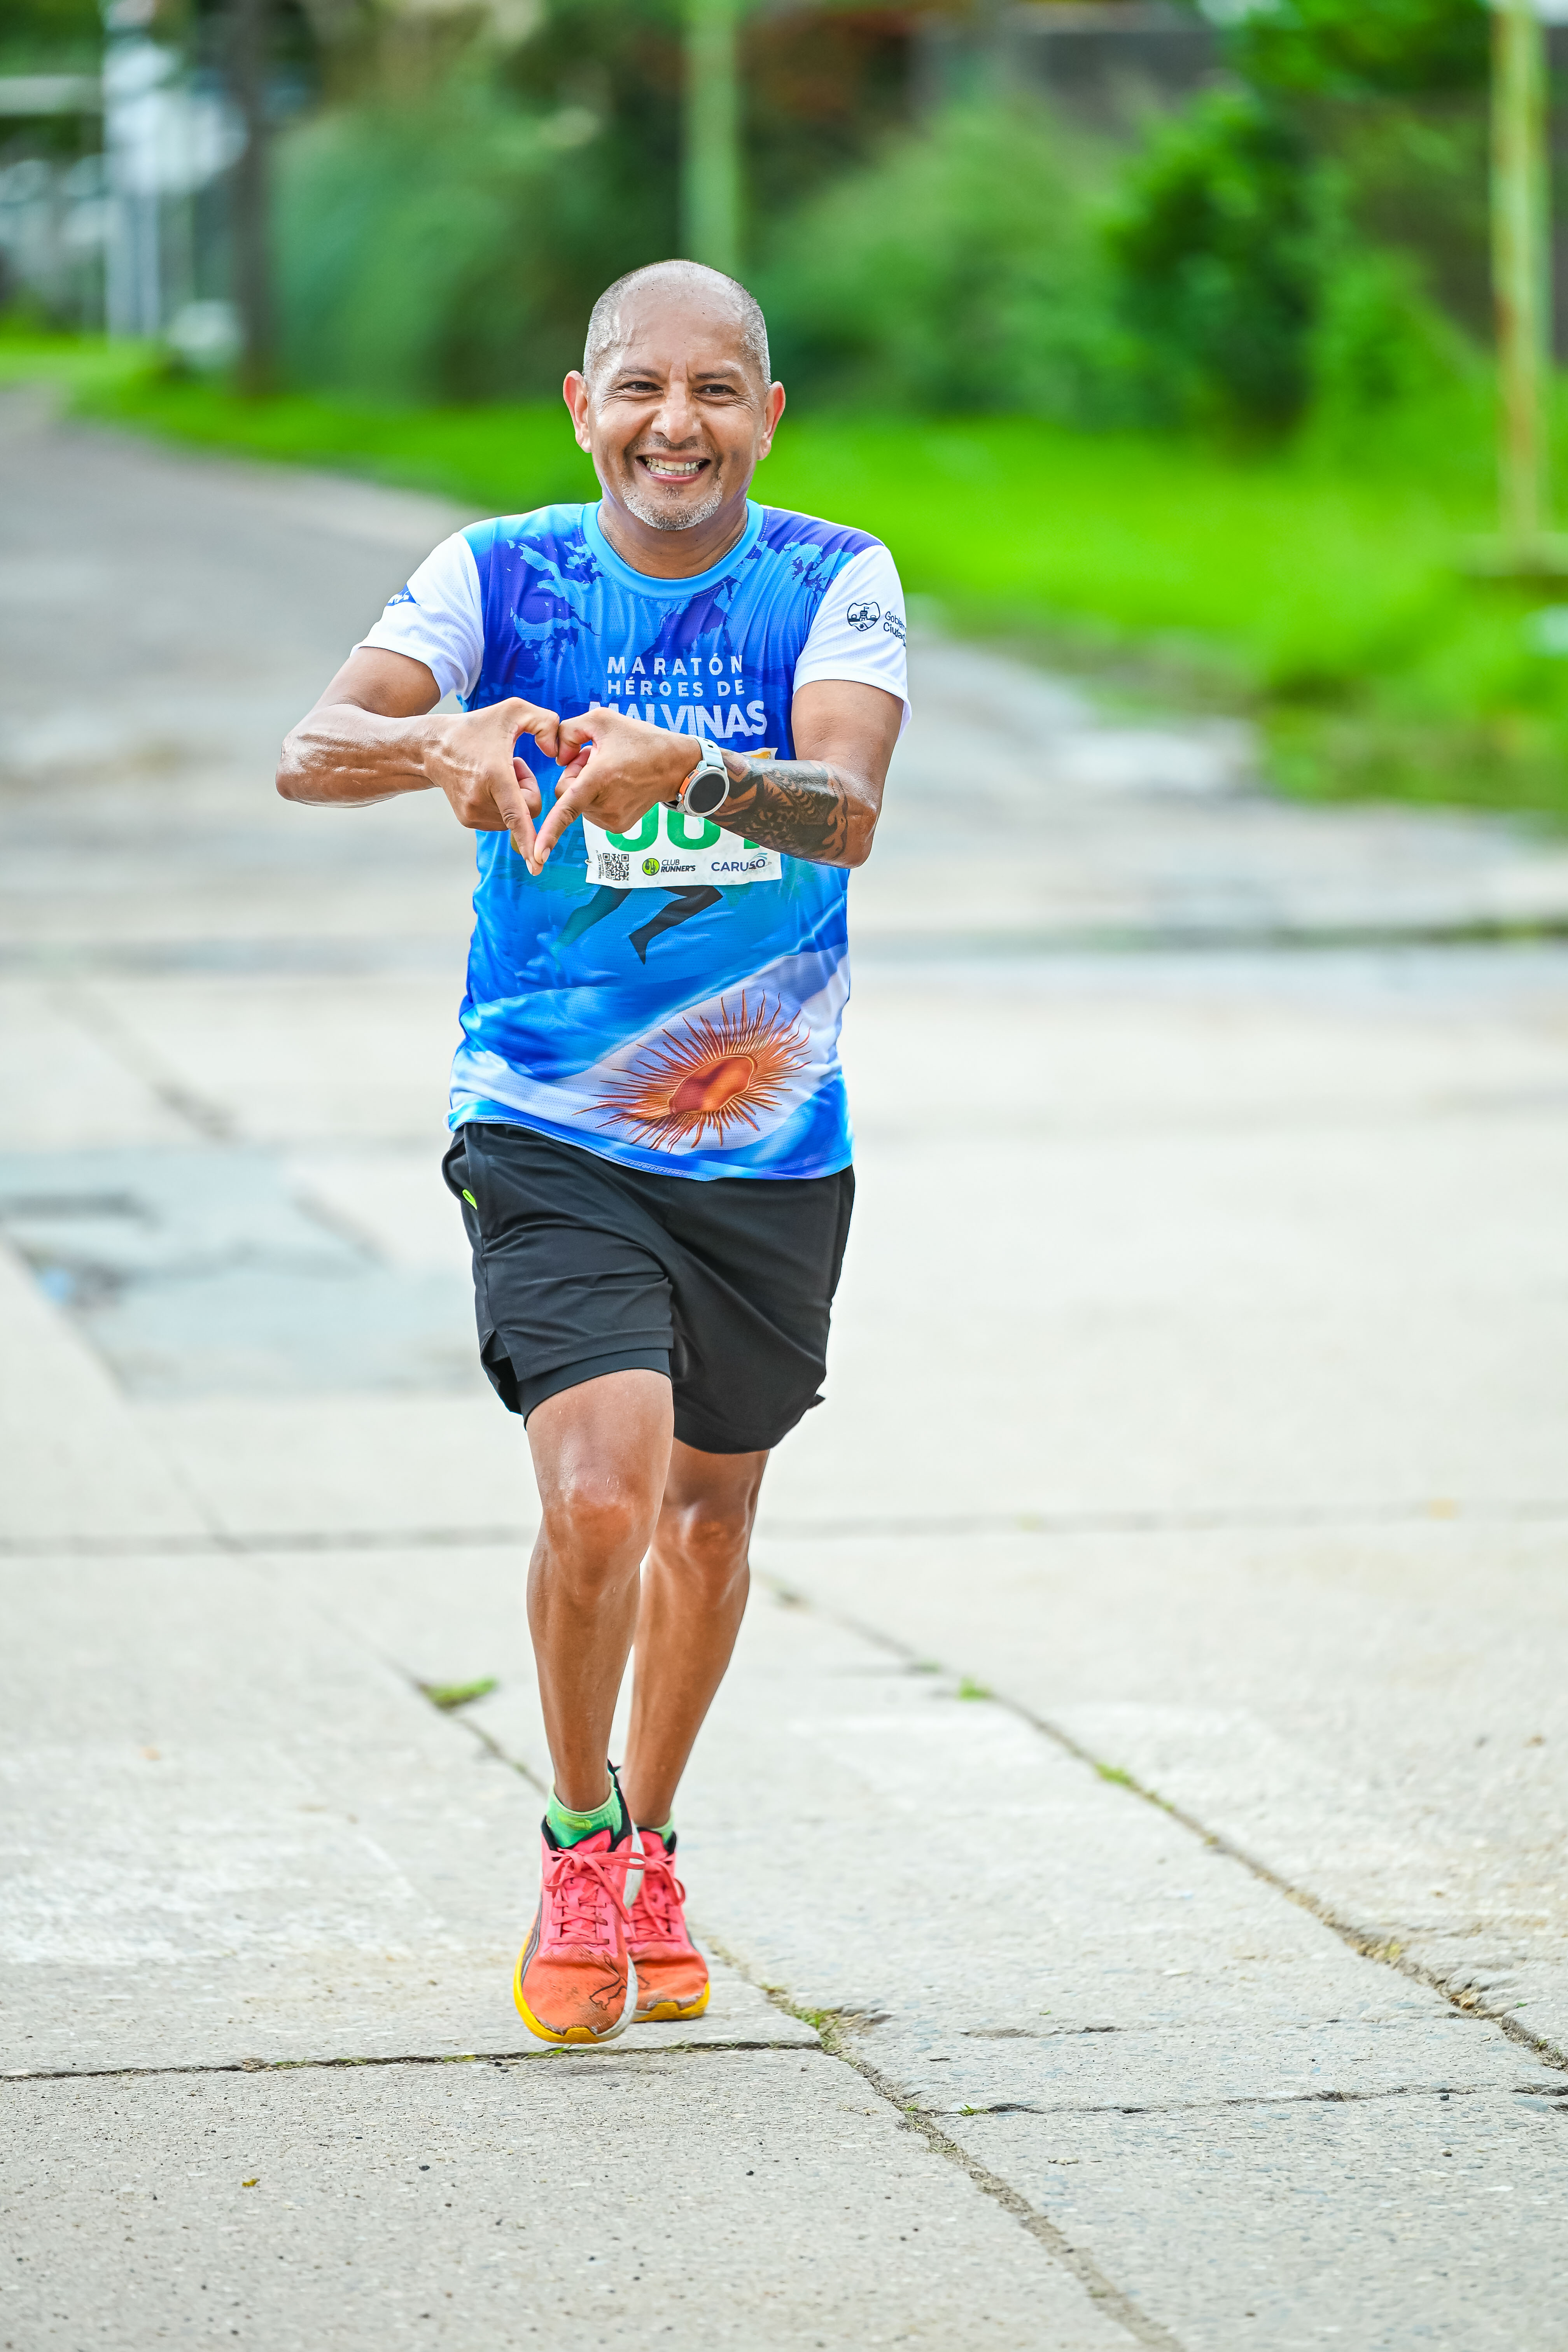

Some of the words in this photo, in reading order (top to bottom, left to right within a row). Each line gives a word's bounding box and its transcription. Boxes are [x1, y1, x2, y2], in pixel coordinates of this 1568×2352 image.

[607, 653, 742, 676] MARATÓN
[608, 677, 703, 697] HÉROES
[718, 679, 745, 697] DE
[589, 700, 767, 739] VINAS
[711, 859, 765, 872] CARUSO
